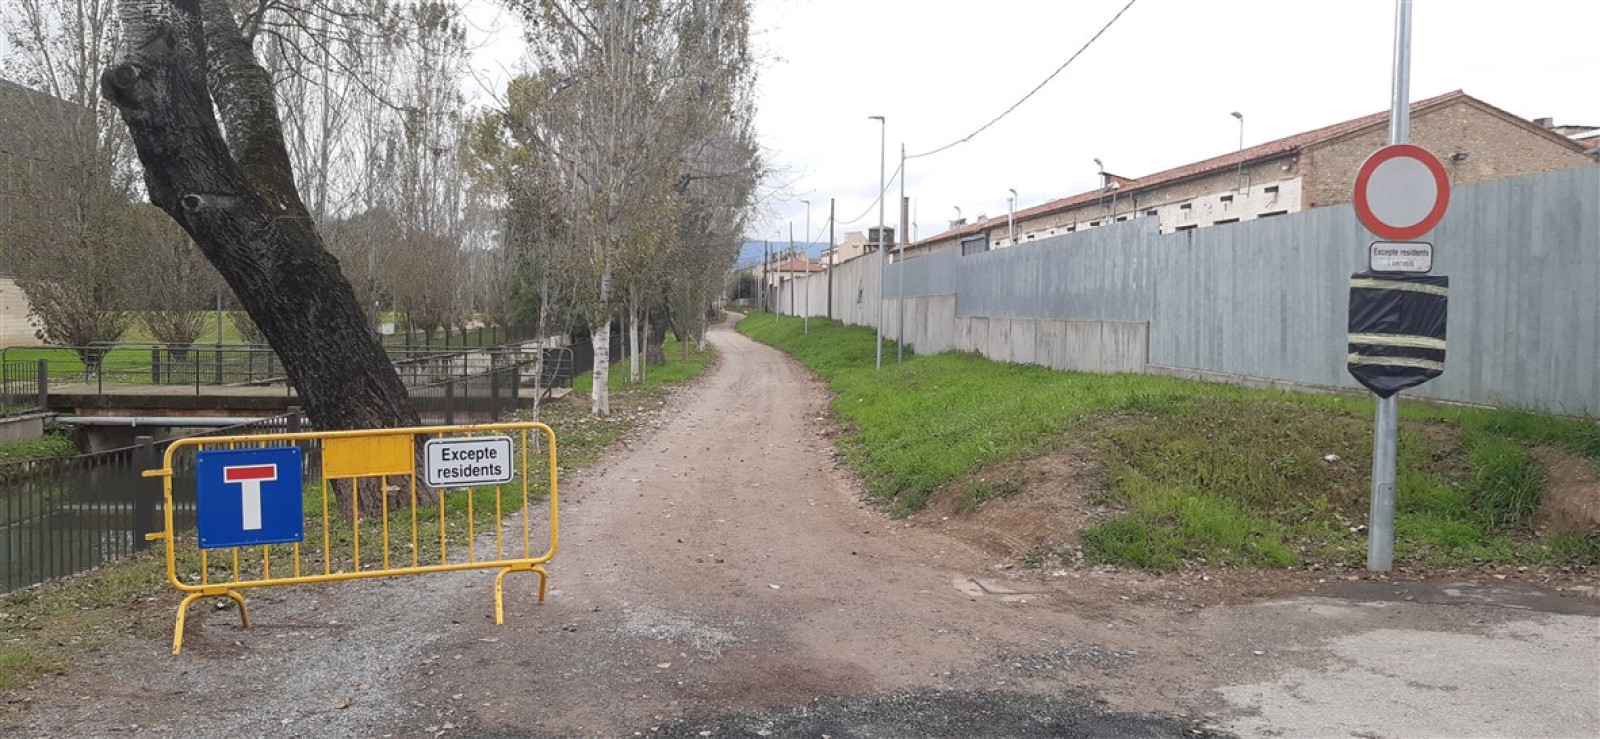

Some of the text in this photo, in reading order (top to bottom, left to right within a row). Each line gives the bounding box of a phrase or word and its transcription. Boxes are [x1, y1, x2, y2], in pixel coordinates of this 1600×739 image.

[1373, 247, 1429, 257] Excepte residents
[442, 447, 497, 463] Excepte
[437, 463, 502, 479] residents
